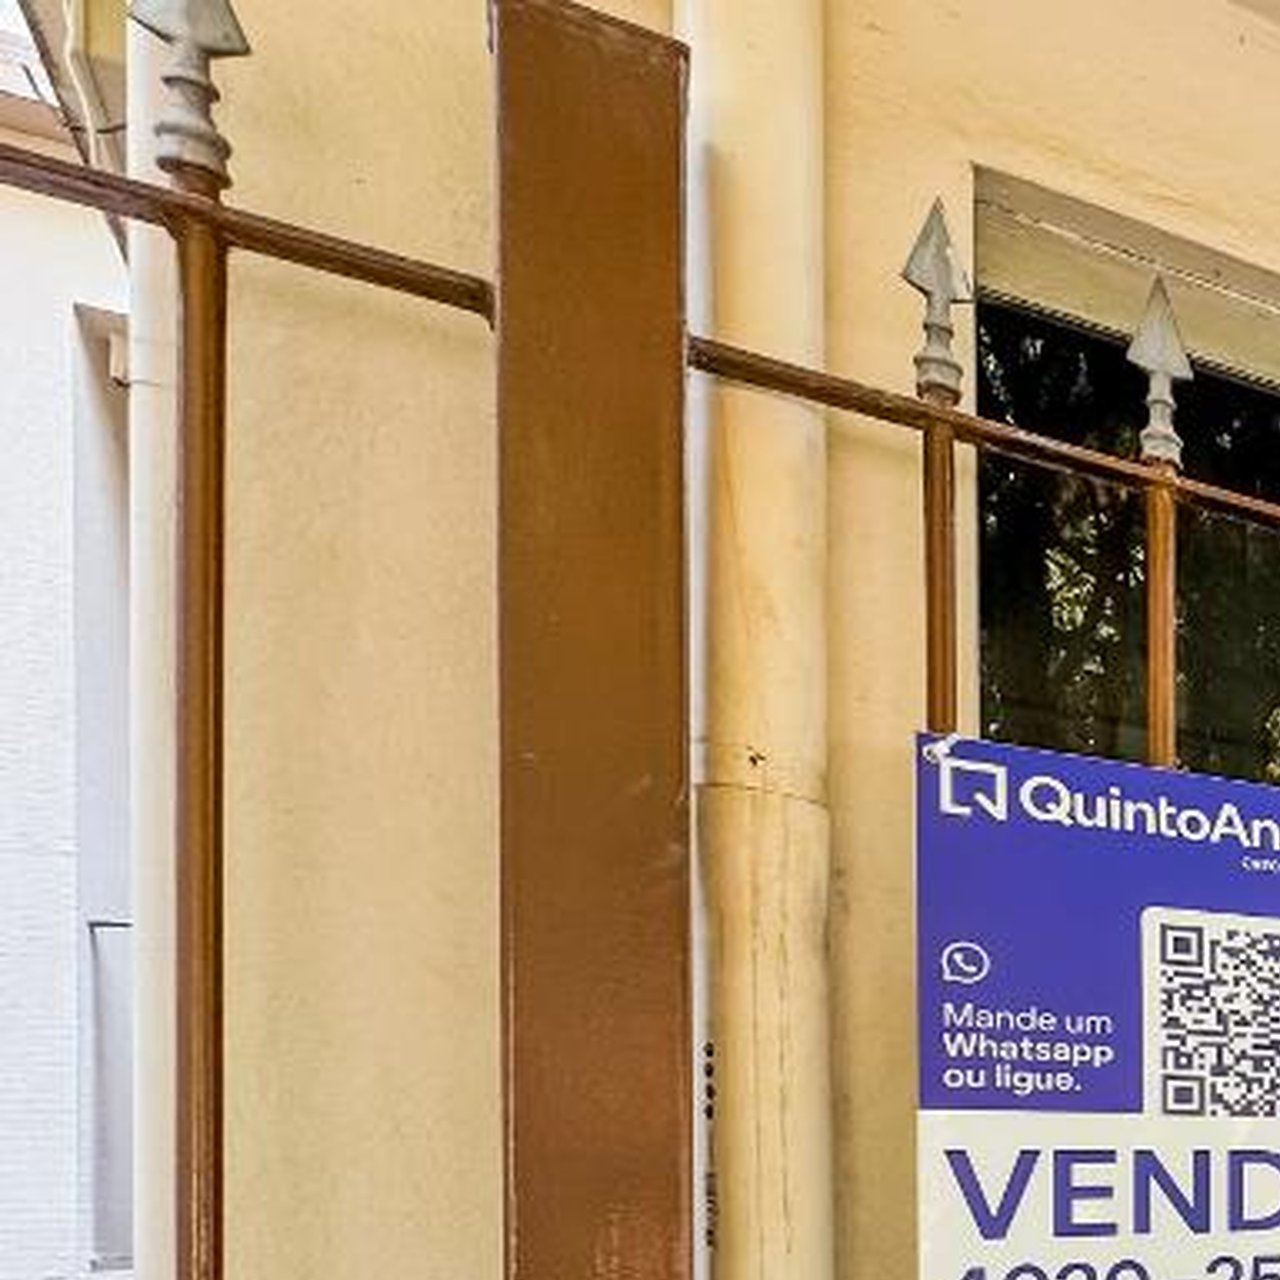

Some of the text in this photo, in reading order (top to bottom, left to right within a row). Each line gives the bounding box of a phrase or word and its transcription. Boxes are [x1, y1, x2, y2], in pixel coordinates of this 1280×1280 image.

[943, 1003, 1112, 1035] Mande um
[943, 1034, 1114, 1068] Whatsapp
[943, 1065, 1082, 1094] ou ligue.
